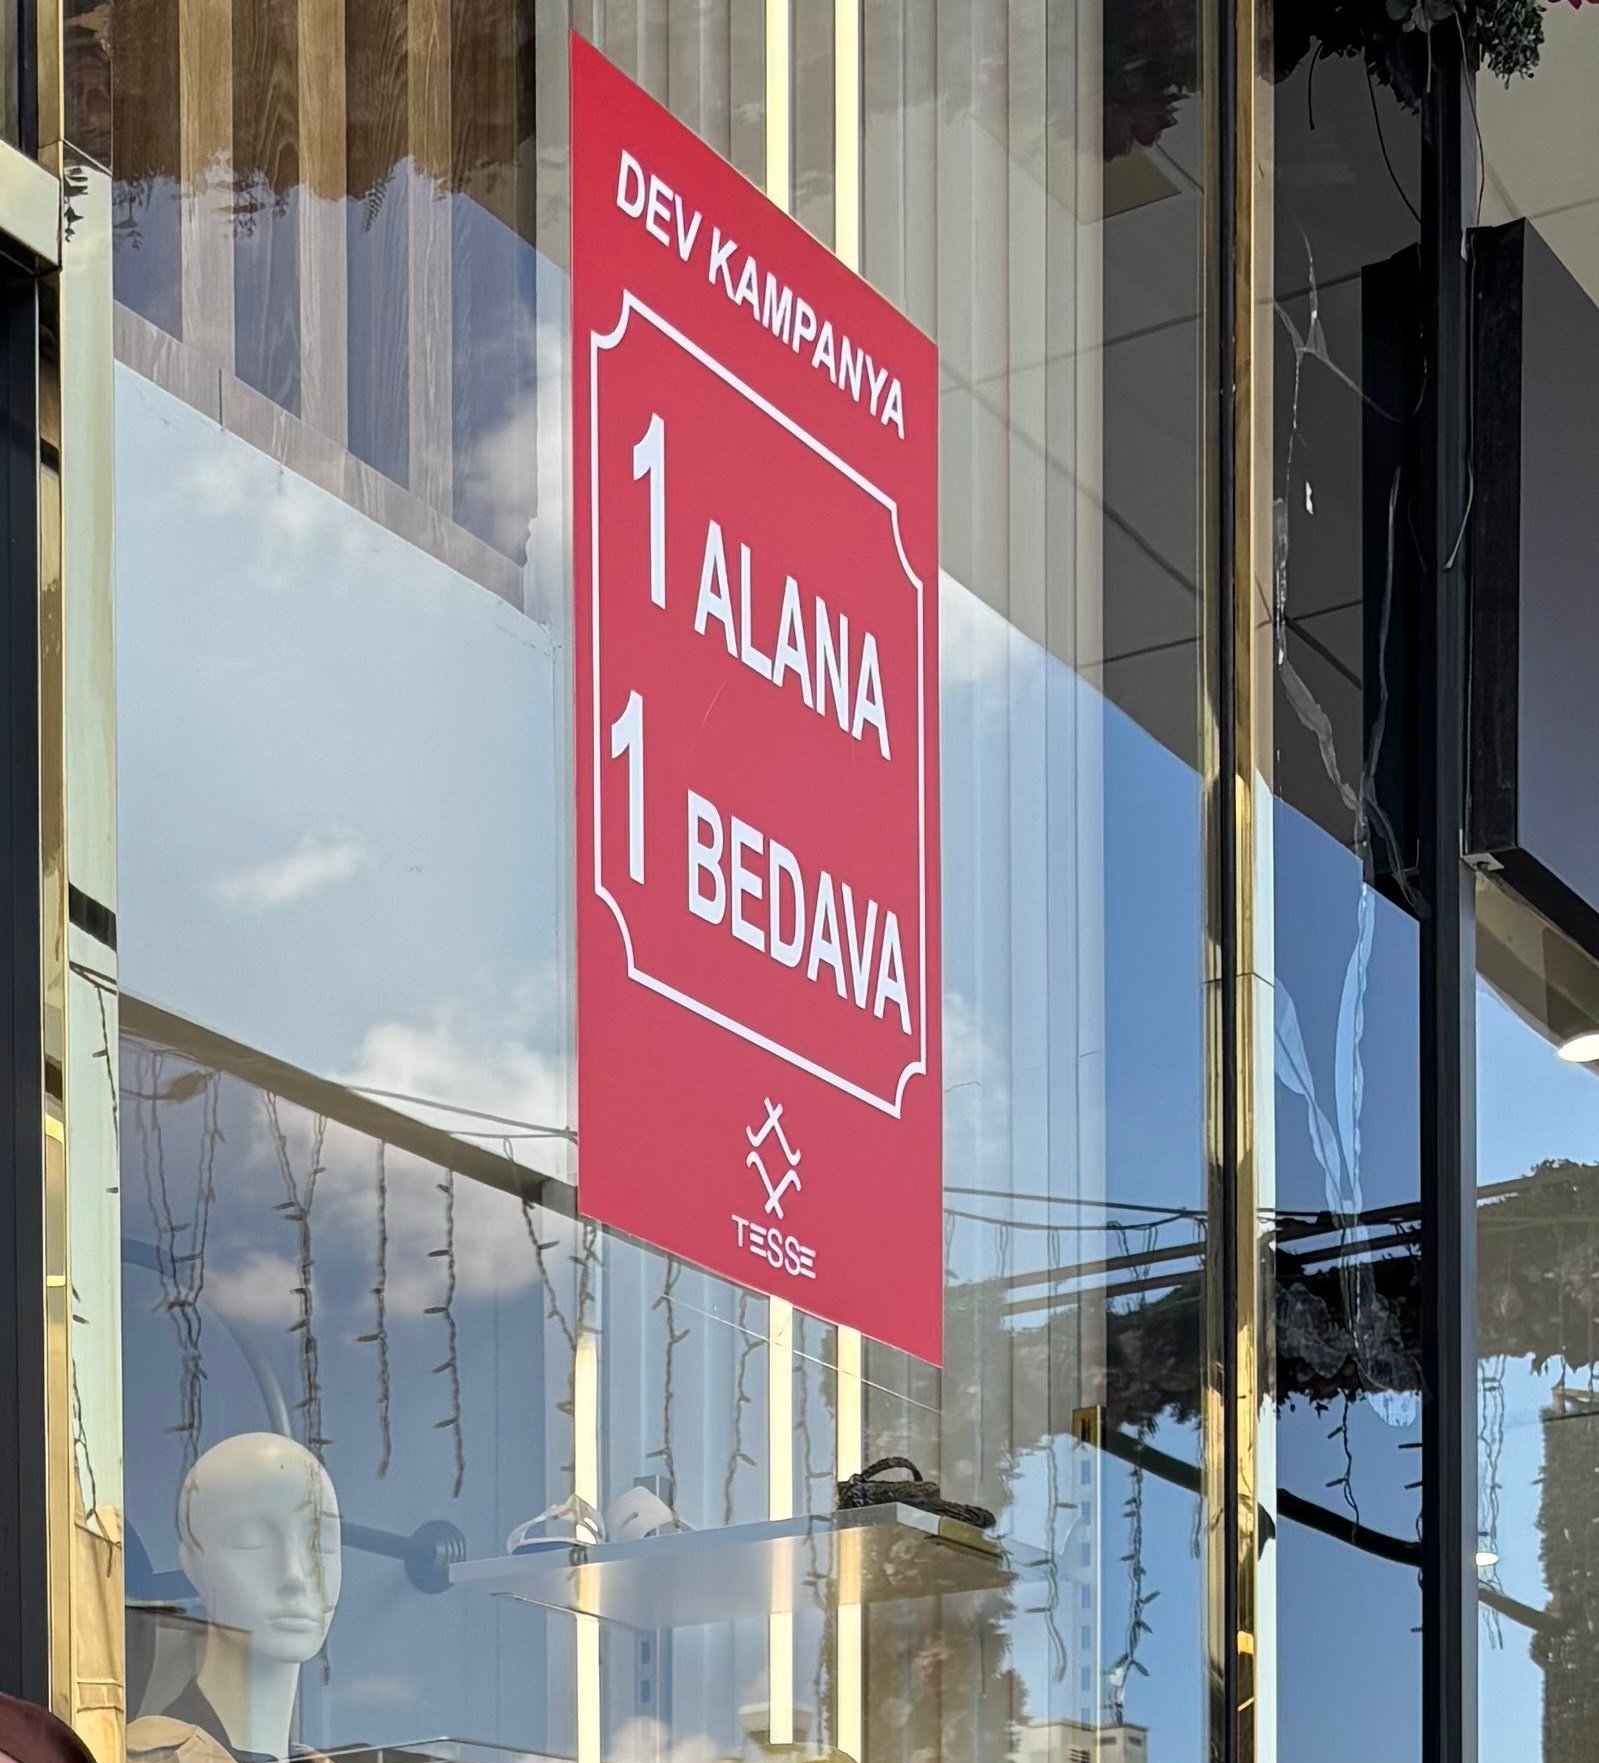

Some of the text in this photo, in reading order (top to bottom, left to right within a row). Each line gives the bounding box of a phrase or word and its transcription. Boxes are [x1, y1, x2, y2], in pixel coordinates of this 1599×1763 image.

[616, 149, 905, 440] DEV KAMPANYA
[633, 412, 891, 761] 1 ALANA
[611, 689, 912, 1035] 1 BEDAVA
[731, 1214, 817, 1280] TESSE
